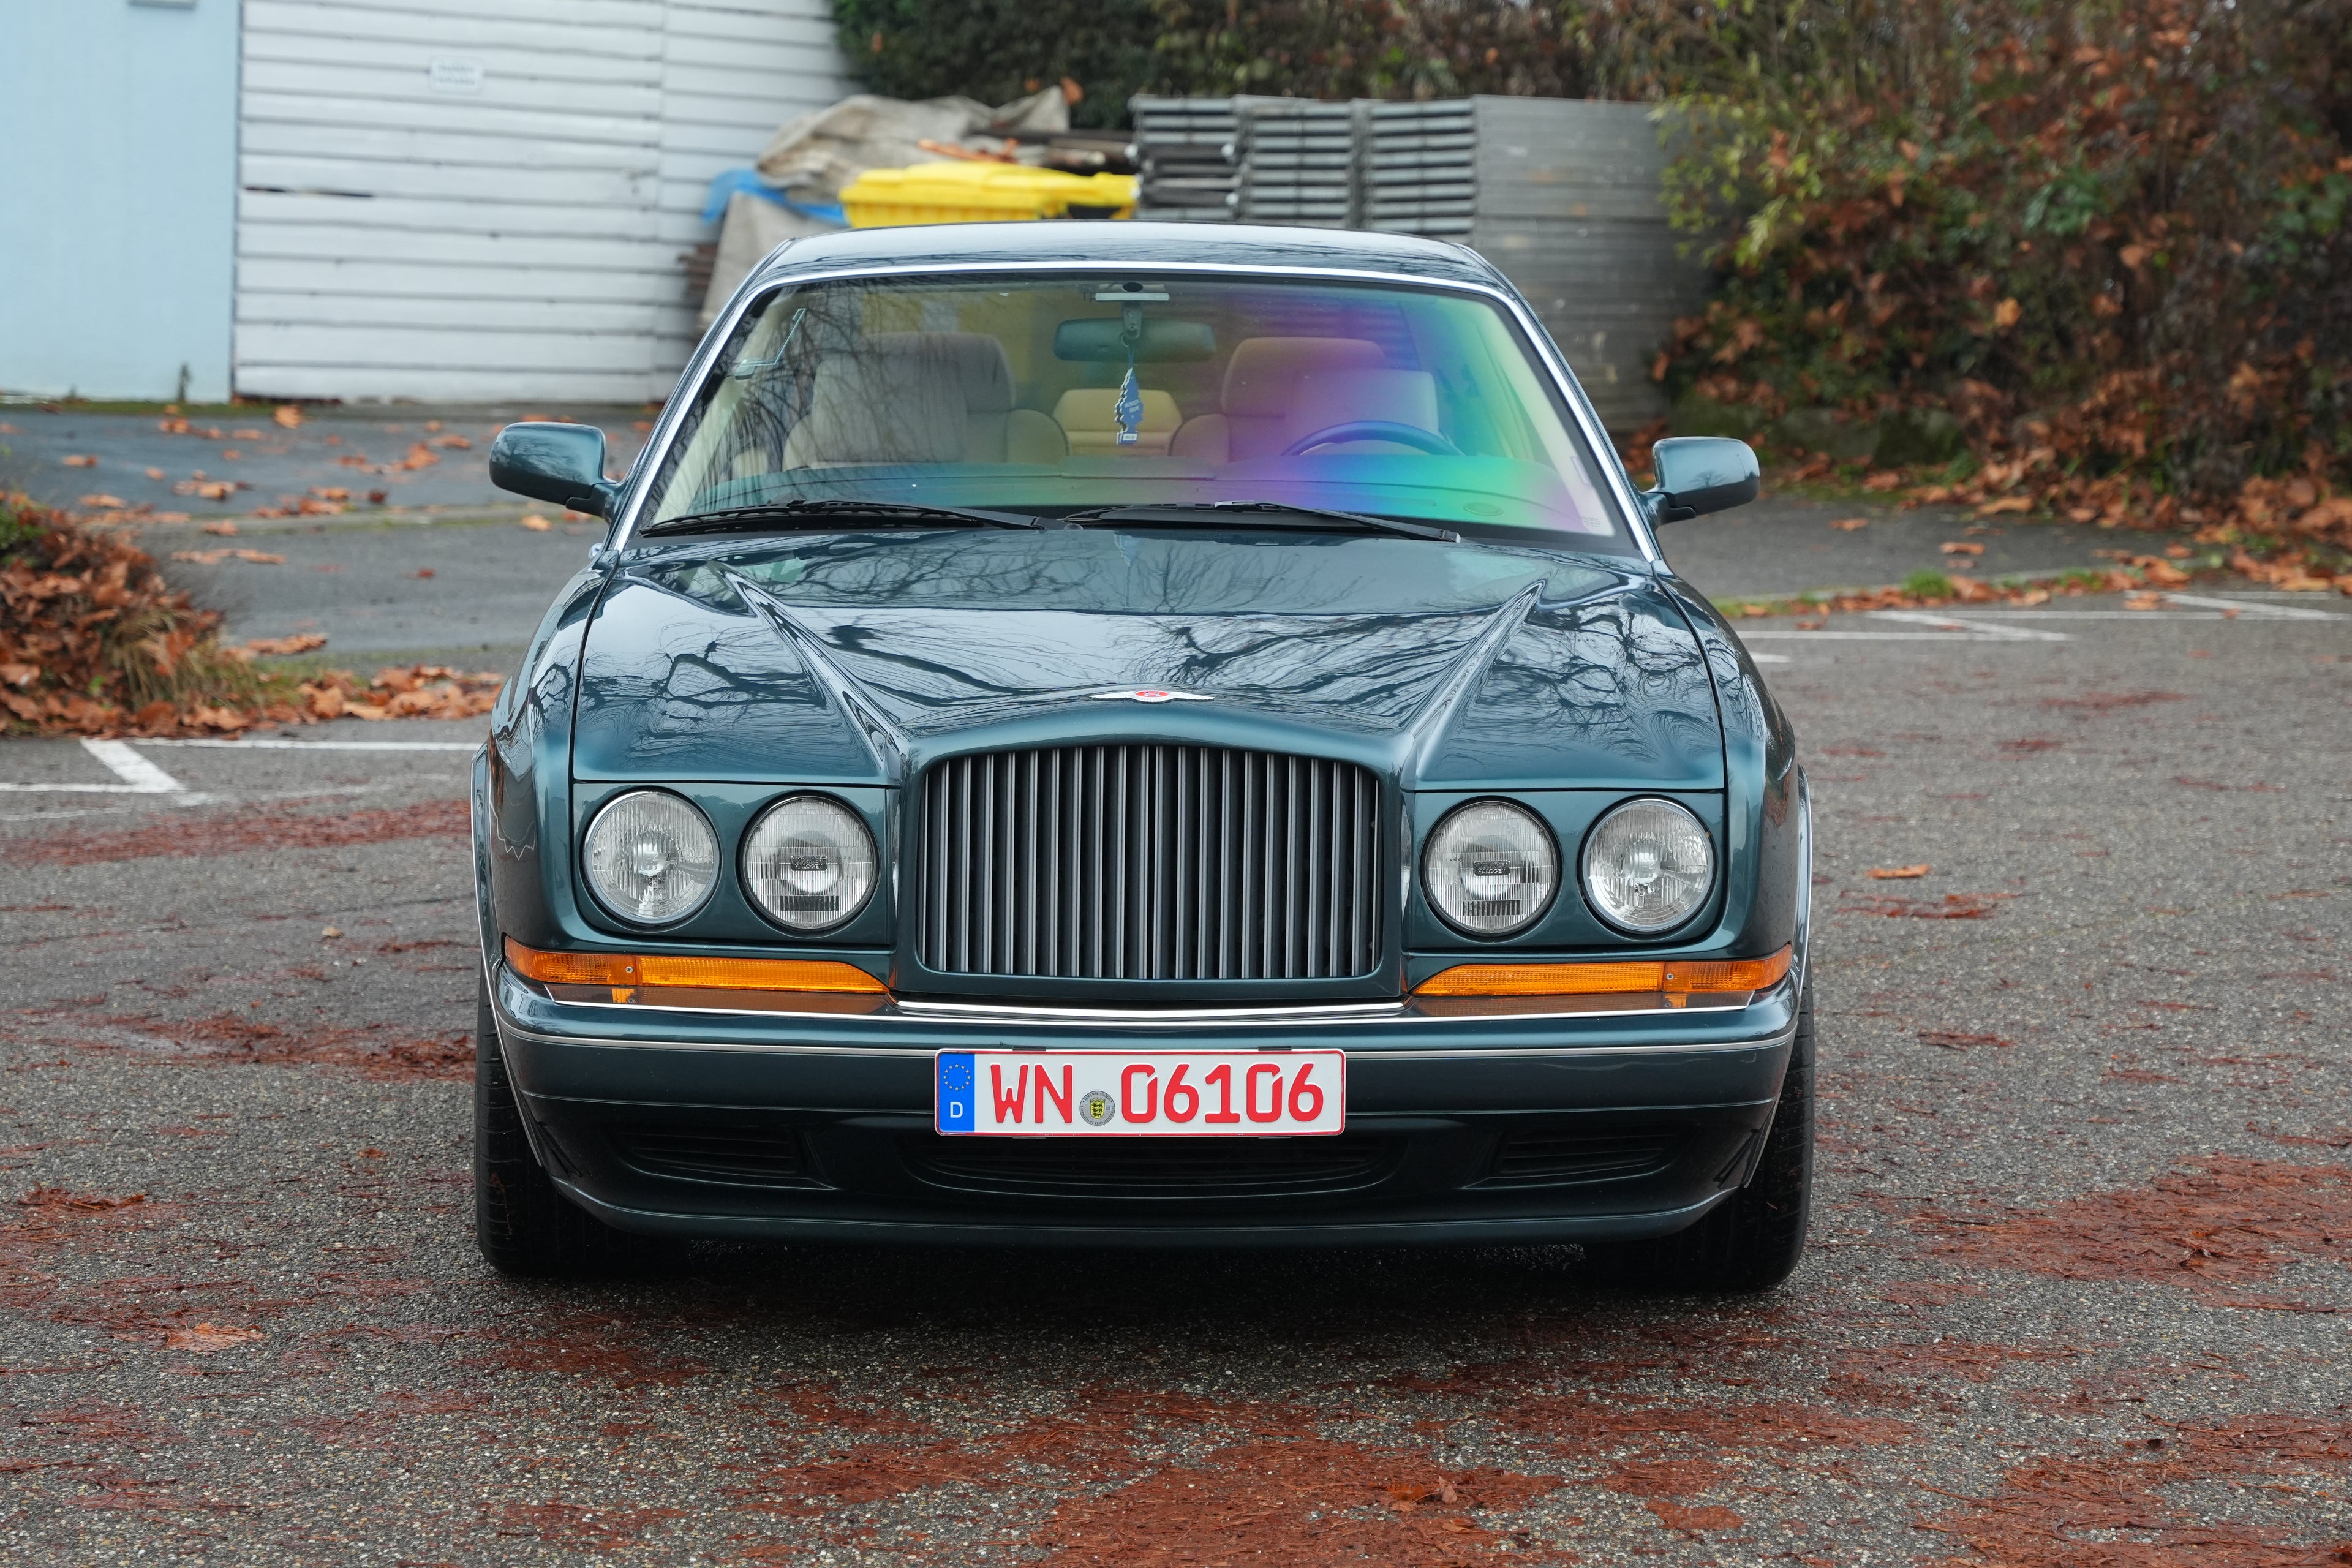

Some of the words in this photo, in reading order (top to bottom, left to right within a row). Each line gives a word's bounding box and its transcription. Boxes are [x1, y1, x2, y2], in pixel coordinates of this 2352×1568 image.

[949, 1101, 963, 1118] D
[990, 1063, 1073, 1124] WN
[1120, 1063, 1324, 1123] 06106
